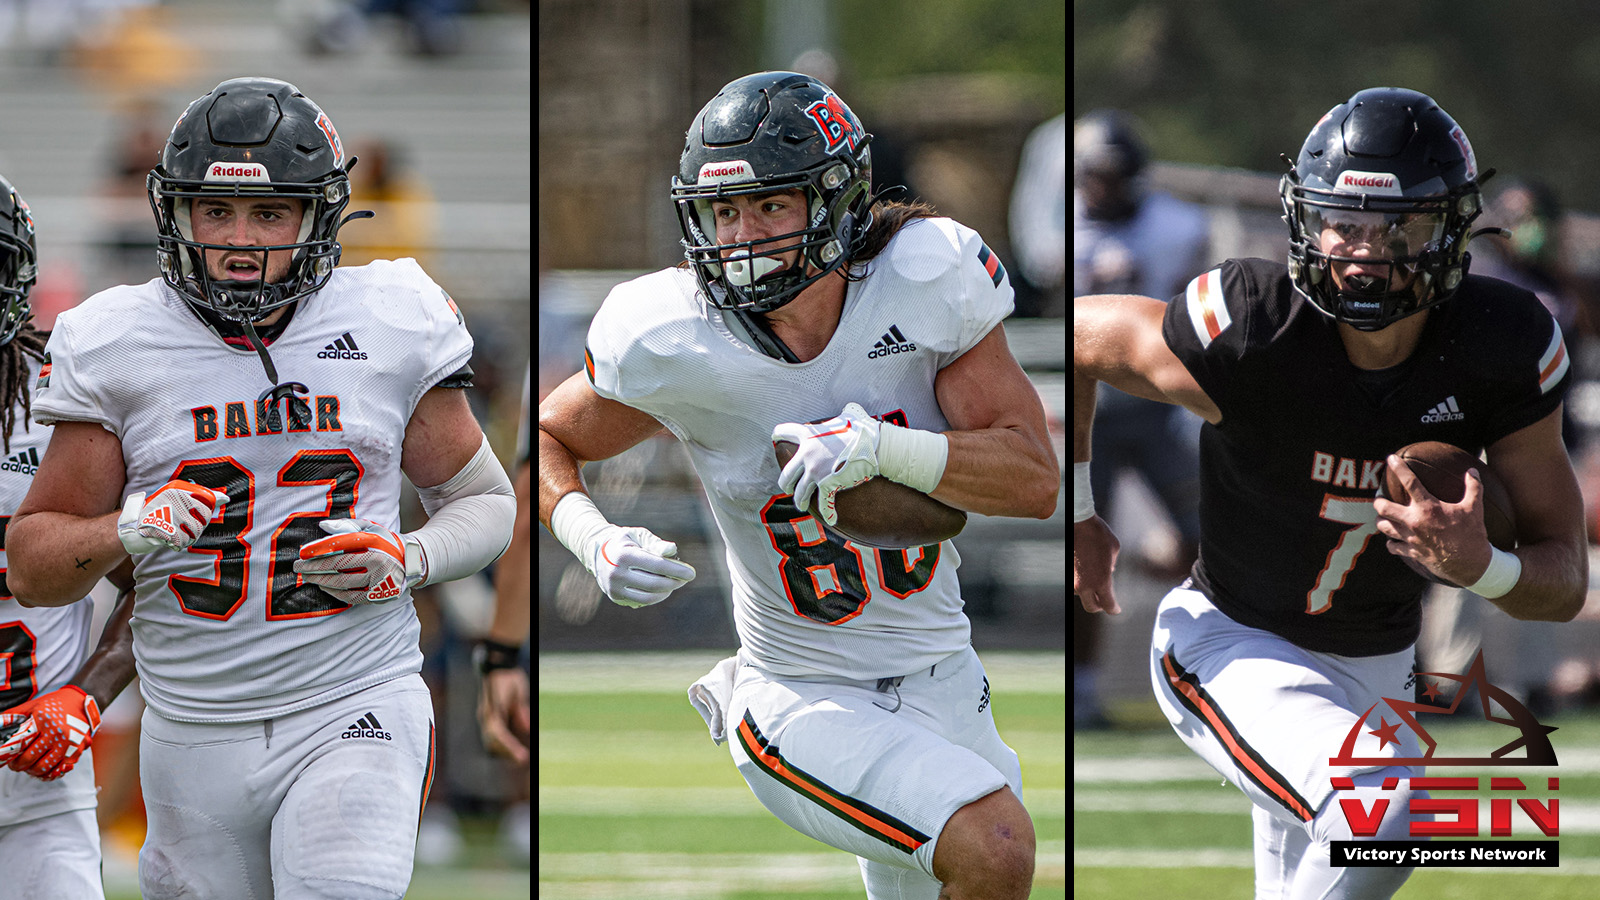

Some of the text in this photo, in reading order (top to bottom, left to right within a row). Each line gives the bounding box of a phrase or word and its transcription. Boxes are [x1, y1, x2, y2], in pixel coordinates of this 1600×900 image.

[212, 165, 261, 177] Riddell
[702, 165, 744, 178] Riddell
[1344, 175, 1394, 188] Riddell
[317, 349, 368, 360] adidas
[868, 342, 917, 359] adidas
[1421, 412, 1464, 423] adidas
[1311, 451, 1386, 489] BAK
[142, 516, 175, 533] adidas
[168, 448, 365, 621] 32
[1304, 492, 1380, 615] 7
[368, 587, 400, 600] adidas
[341, 727, 392, 741] adidas
